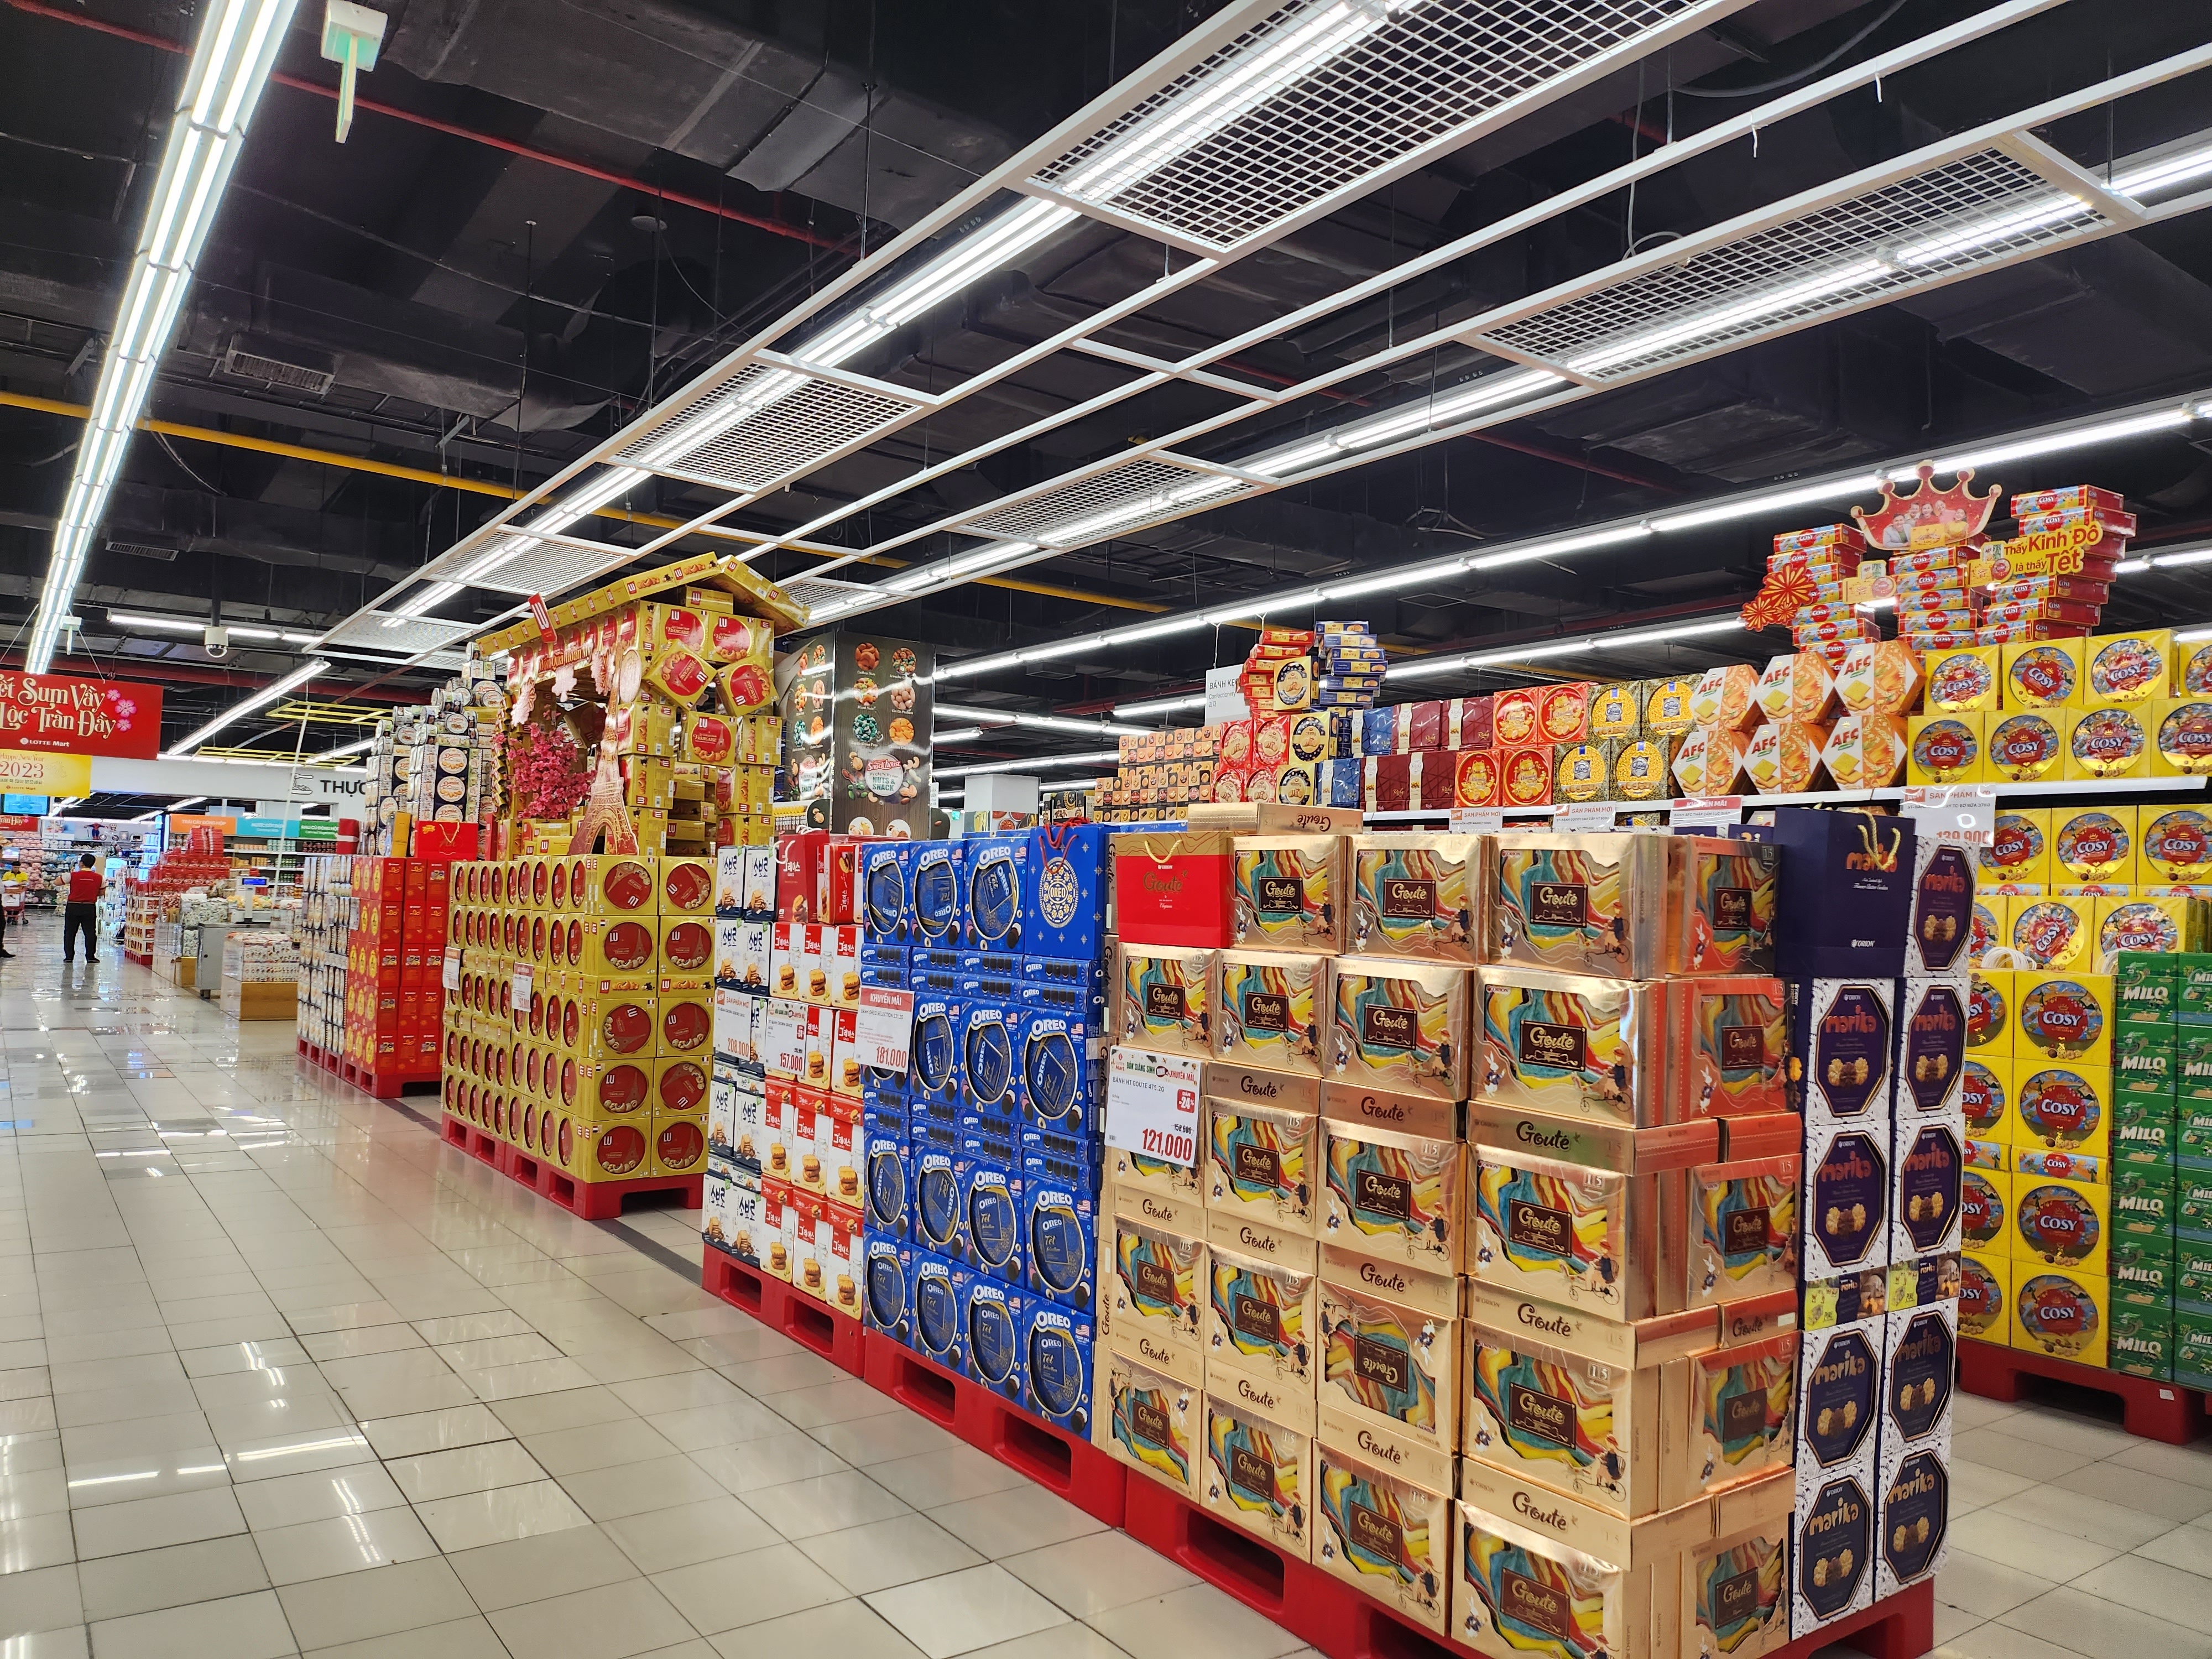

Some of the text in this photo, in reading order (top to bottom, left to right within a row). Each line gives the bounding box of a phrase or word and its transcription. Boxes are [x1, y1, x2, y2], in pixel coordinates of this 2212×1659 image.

[2004, 524, 2099, 556] Thấy Kinh Đô
[2016, 546, 2081, 573] là thấy Tết
[671, 611, 680, 620] LU
[1844, 655, 1871, 675] AFC
[2109, 663, 2143, 681] COSY
[0, 677, 14, 698] ết
[18, 677, 68, 706] Sum
[1209, 679, 1235, 690] BÁNH KẸ
[1698, 676, 1723, 695] AFC
[1946, 675, 1978, 692] COSY
[1209, 691, 1236, 700] Confectionery
[699, 718, 708, 728] LU
[1832, 728, 1859, 747] AFC
[2090, 737, 2124, 750] COSY
[1929, 744, 1961, 757] COSY
[0, 761, 44, 779] 2023
[872, 783, 894, 791] SNACK
[1714, 799, 1727, 807] MÃI
[1995, 838, 2025, 856] COSY
[2164, 838, 2201, 852] COSY
[871, 851, 896, 867] OREO
[979, 847, 1011, 863] OREO
[1051, 886, 1066, 898] OREO
[1265, 880, 1296, 898] Gouté
[1391, 883, 1427, 902] Gouté
[2121, 931, 2156, 947] COSY
[870, 992, 901, 1006] KHUYẾN MÃI
[2122, 986, 2168, 1001] MILO
[919, 1003, 946, 1016] OREO
[1032, 1019, 1067, 1036] OREO
[2042, 1011, 2082, 1027] COSY
[1530, 1025, 1576, 1050] Gouté
[780, 1052, 803, 1072] 157,000
[876, 1046, 907, 1068] 181,000
[2121, 1056, 2166, 1072] MILO
[1113, 1076, 1125, 1084] BÁNH
[1133, 1081, 1147, 1089] GOUTE
[1241, 1074, 1277, 1098] Gouté
[1516, 1120, 1570, 1150] Gouté
[1142, 1128, 1192, 1161] 121,000
[2047, 1159, 2067, 1169] COSY
[1037, 1190, 1073, 1207] OREO
[2119, 1197, 2164, 1212] MILO
[2039, 1215, 2078, 1232] COSY
[1240, 1226, 1275, 1253] Gouté
[1036, 1311, 1071, 1329] OREO
[1041, 1338, 1062, 1349] OREO
[1888, 1468, 1934, 1505] marika
[1512, 1491, 1567, 1531] Gouté
[1809, 1498, 1859, 1536] marika
